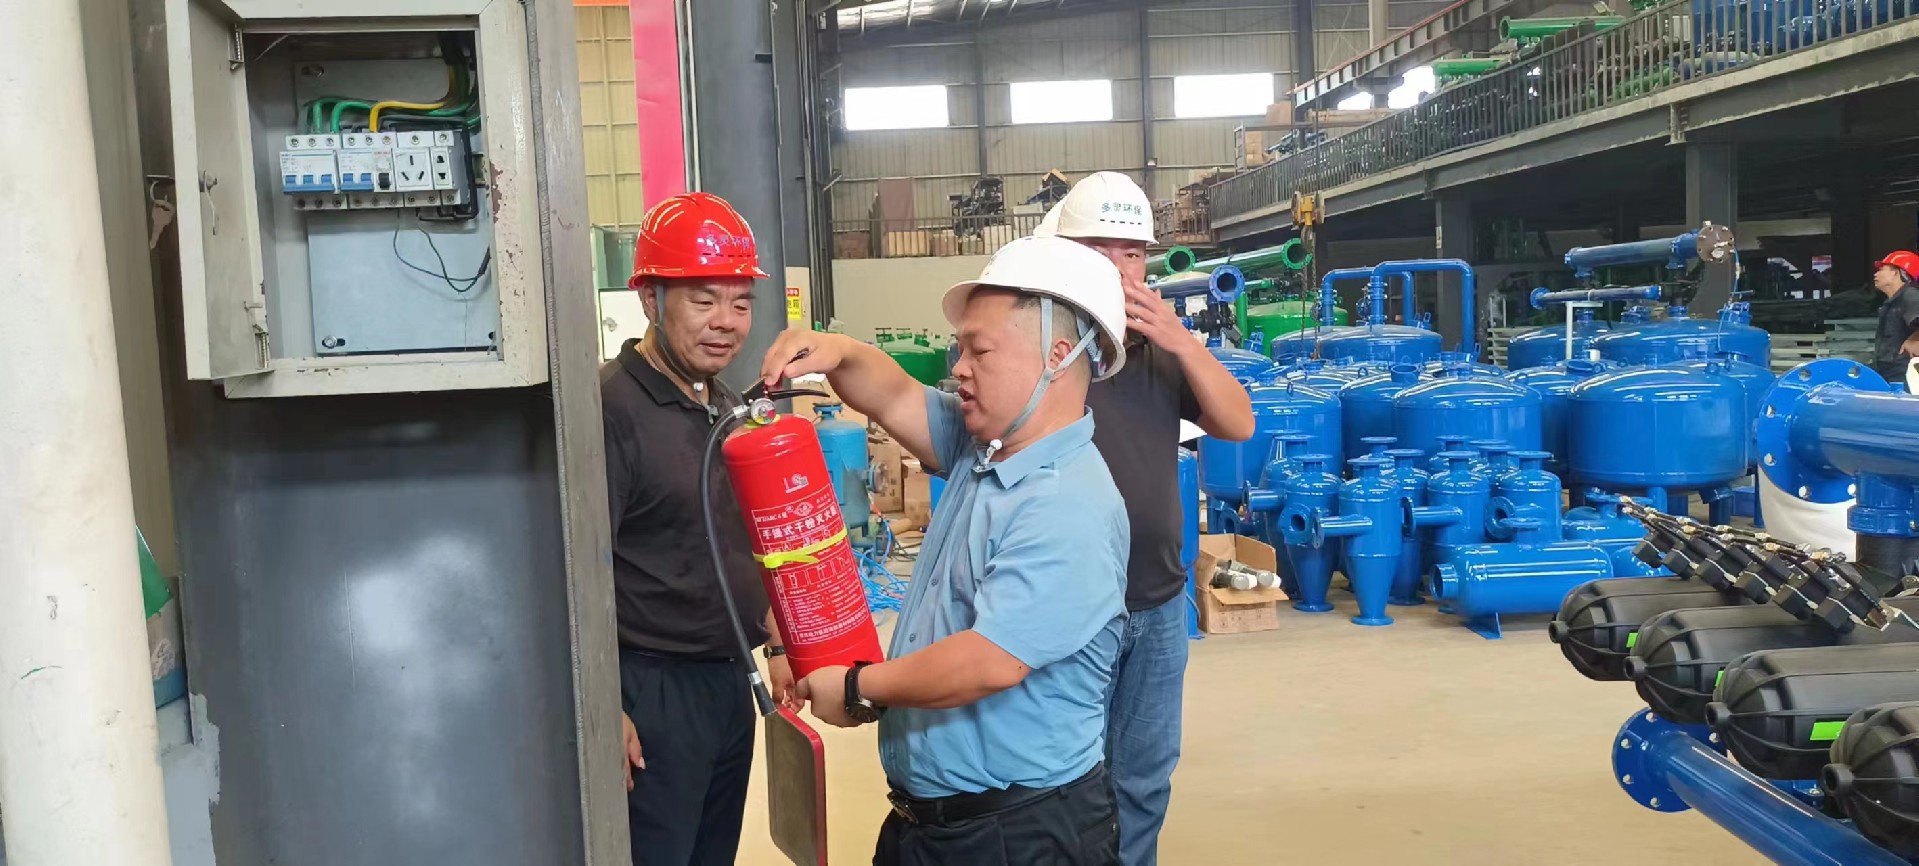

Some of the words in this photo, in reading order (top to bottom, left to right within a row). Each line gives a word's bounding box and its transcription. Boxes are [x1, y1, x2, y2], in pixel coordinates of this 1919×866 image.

[762, 505, 837, 540] 手提式干粉灭火器
